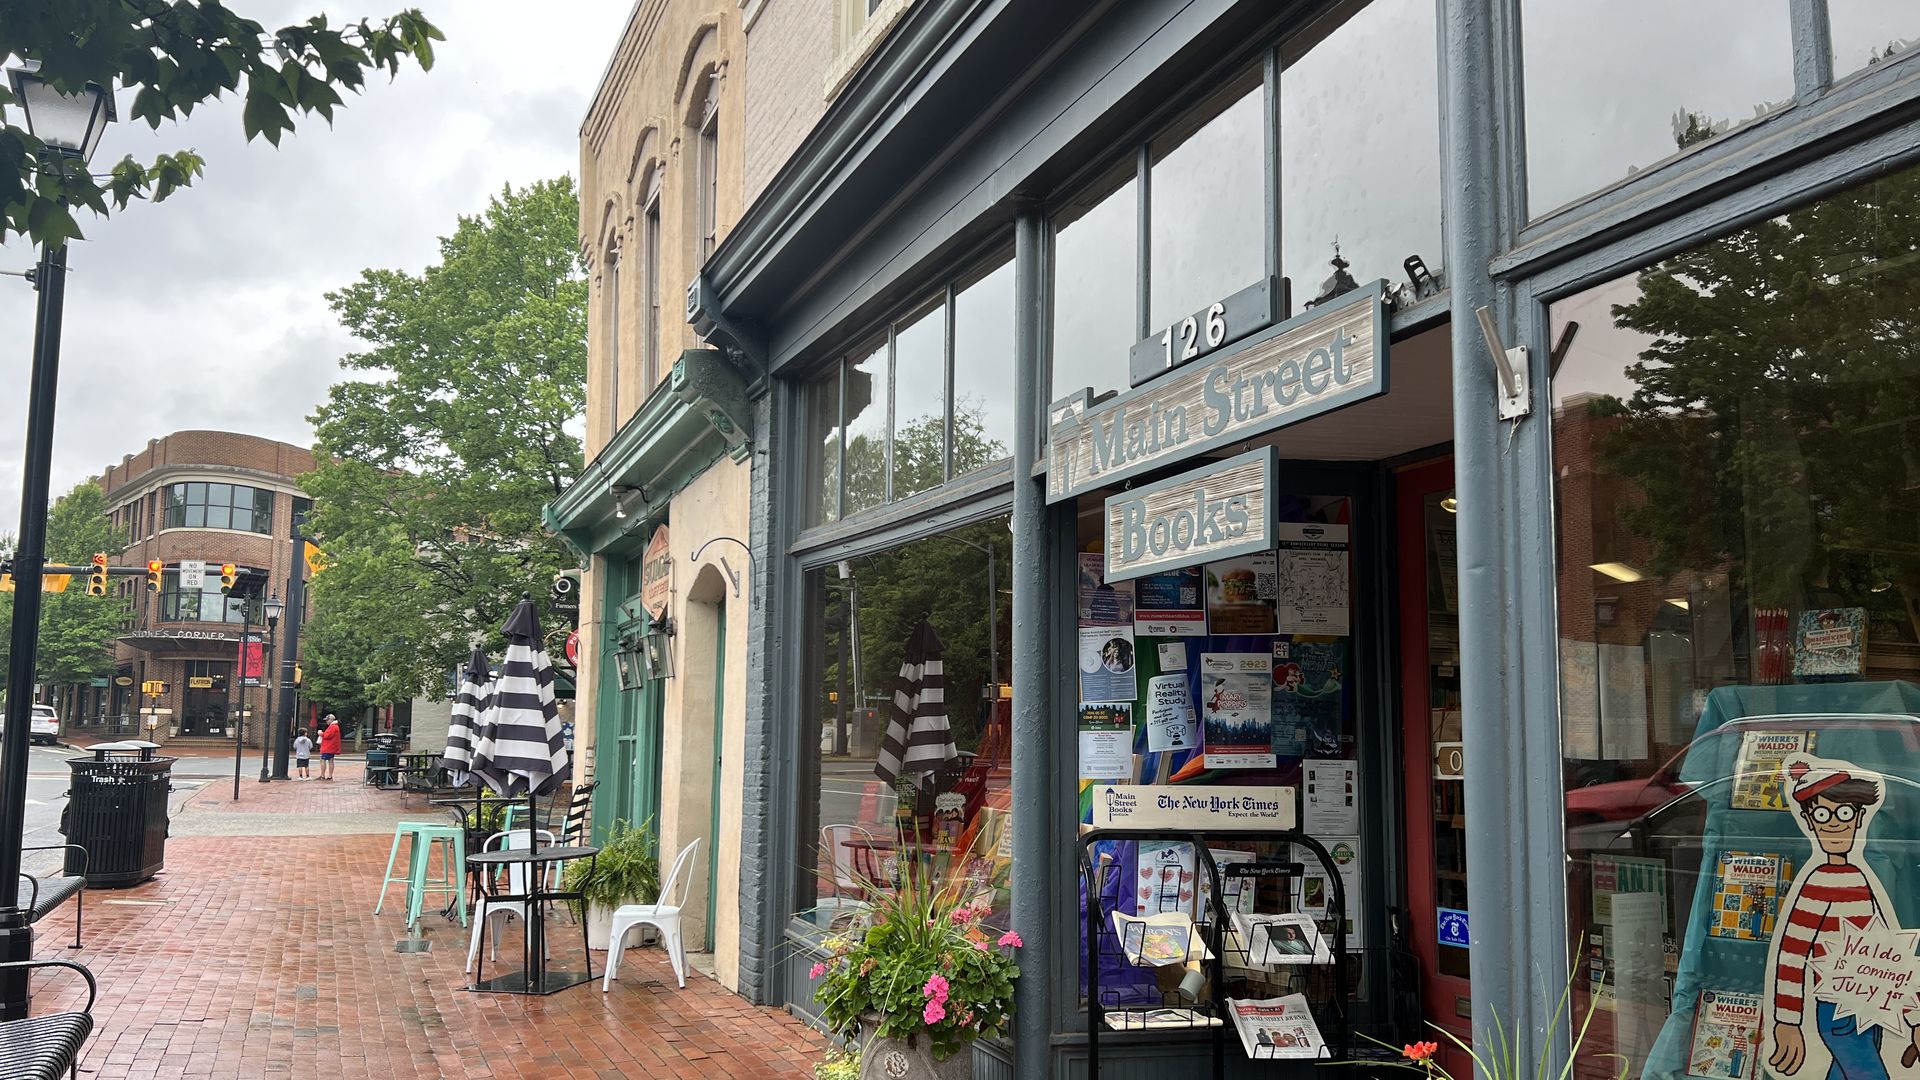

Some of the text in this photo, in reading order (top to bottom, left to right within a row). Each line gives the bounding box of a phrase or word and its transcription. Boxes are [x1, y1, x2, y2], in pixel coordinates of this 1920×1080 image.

[1161, 302, 1226, 368] 126
[1090, 327, 1353, 475] Main Street
[1121, 489, 1249, 563] Books
[177, 630, 225, 640] CORNER
[1239, 660, 1268, 668] 2023
[1155, 681, 1185, 690] Virtual
[1155, 690, 1186, 698] Reality
[1220, 693, 1242, 701] MARY
[1158, 697, 1186, 705] Study
[1217, 700, 1248, 709] POPPINS
[1758, 735, 1799, 743] WHERE'S
[1757, 743, 1799, 751] WALDO?
[1157, 795, 1279, 813] The New York Times
[1734, 858, 1776, 867] WHERE'S
[1240, 867, 1291, 876] The New York Times
[1733, 865, 1776, 875] WALDO?
[1843, 935, 1902, 962] Waldo
[1834, 957, 1913, 989] is coming!
[1832, 975, 1879, 1002] JULY
[1717, 996, 1758, 1007] WHERE'S
[1716, 1004, 1757, 1015] WALDO?
